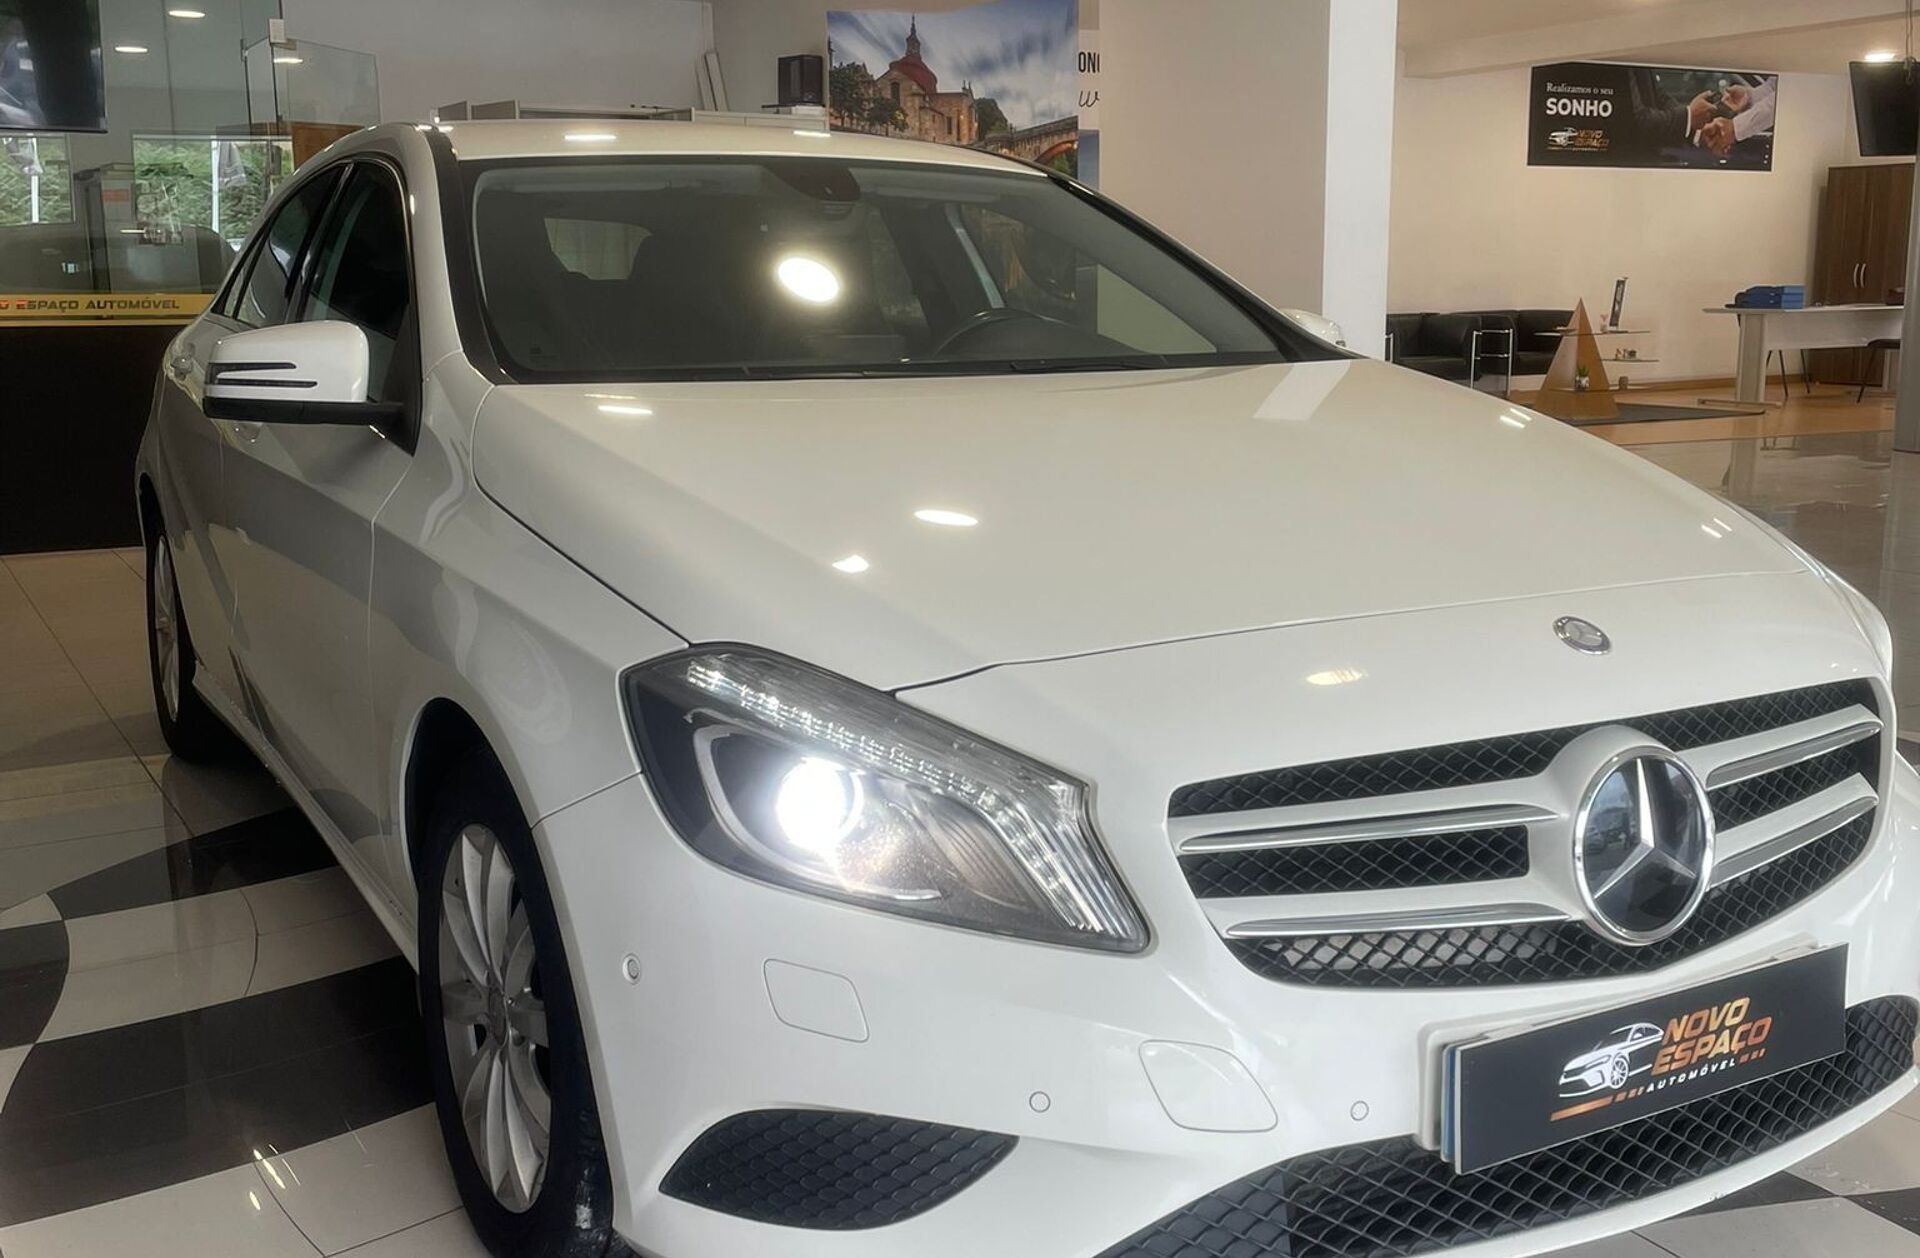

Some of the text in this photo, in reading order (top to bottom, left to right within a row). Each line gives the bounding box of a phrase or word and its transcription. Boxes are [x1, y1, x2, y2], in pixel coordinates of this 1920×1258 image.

[1546, 82, 1591, 94] Realizamos
[1546, 98, 1613, 117] SONHO
[16, 299, 79, 312] ESPAÇO
[85, 297, 180, 310] AUTOMÓVEL
[1662, 997, 1750, 1046] NOVO
[1651, 1016, 1772, 1076] ESPAÇO
[1646, 1058, 1735, 1093] AUTOMÓVEL
